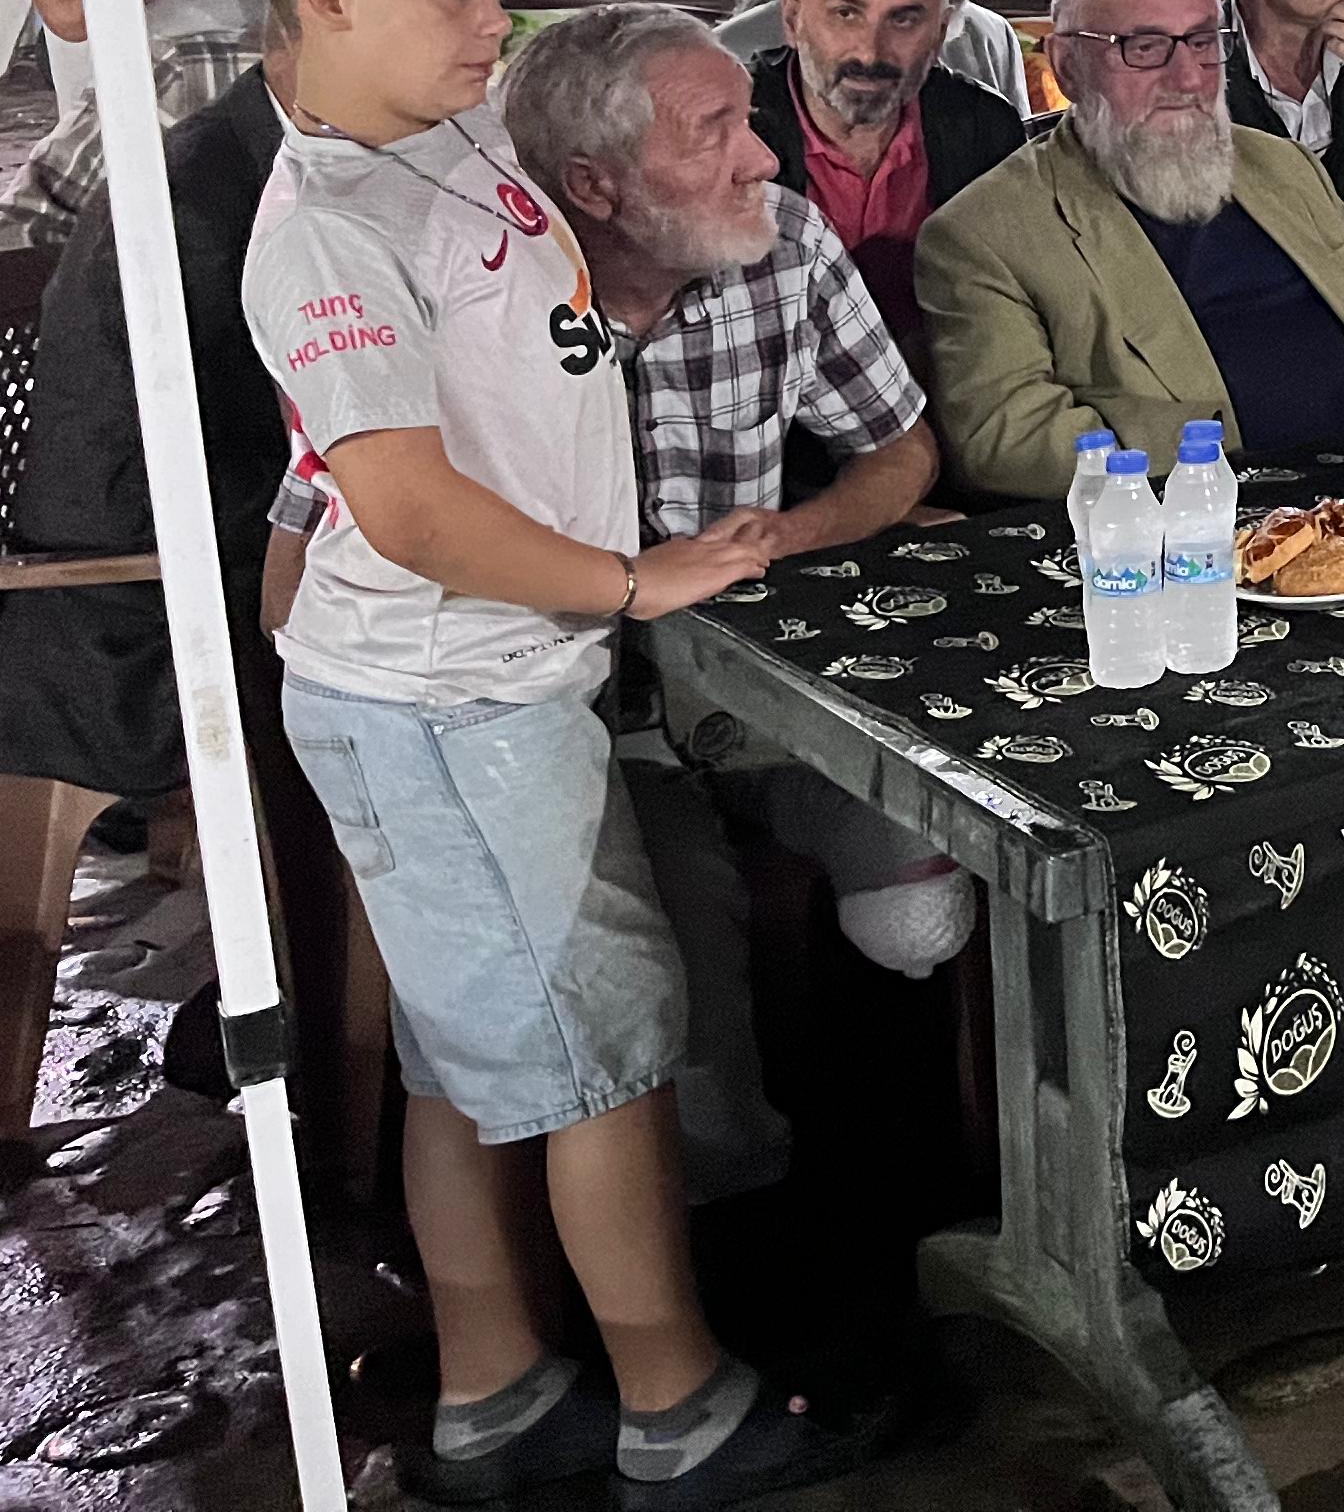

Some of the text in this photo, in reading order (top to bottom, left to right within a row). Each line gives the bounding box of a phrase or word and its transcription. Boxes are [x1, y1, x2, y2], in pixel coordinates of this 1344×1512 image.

[287, 324, 396, 373] HOLDİNG
[1091, 573, 1137, 591] damla
[1156, 898, 1193, 937] DOĞUŞ
[1271, 1003, 1323, 1063] DOĞUŞ
[1172, 1219, 1207, 1255] DOĞUŞ
